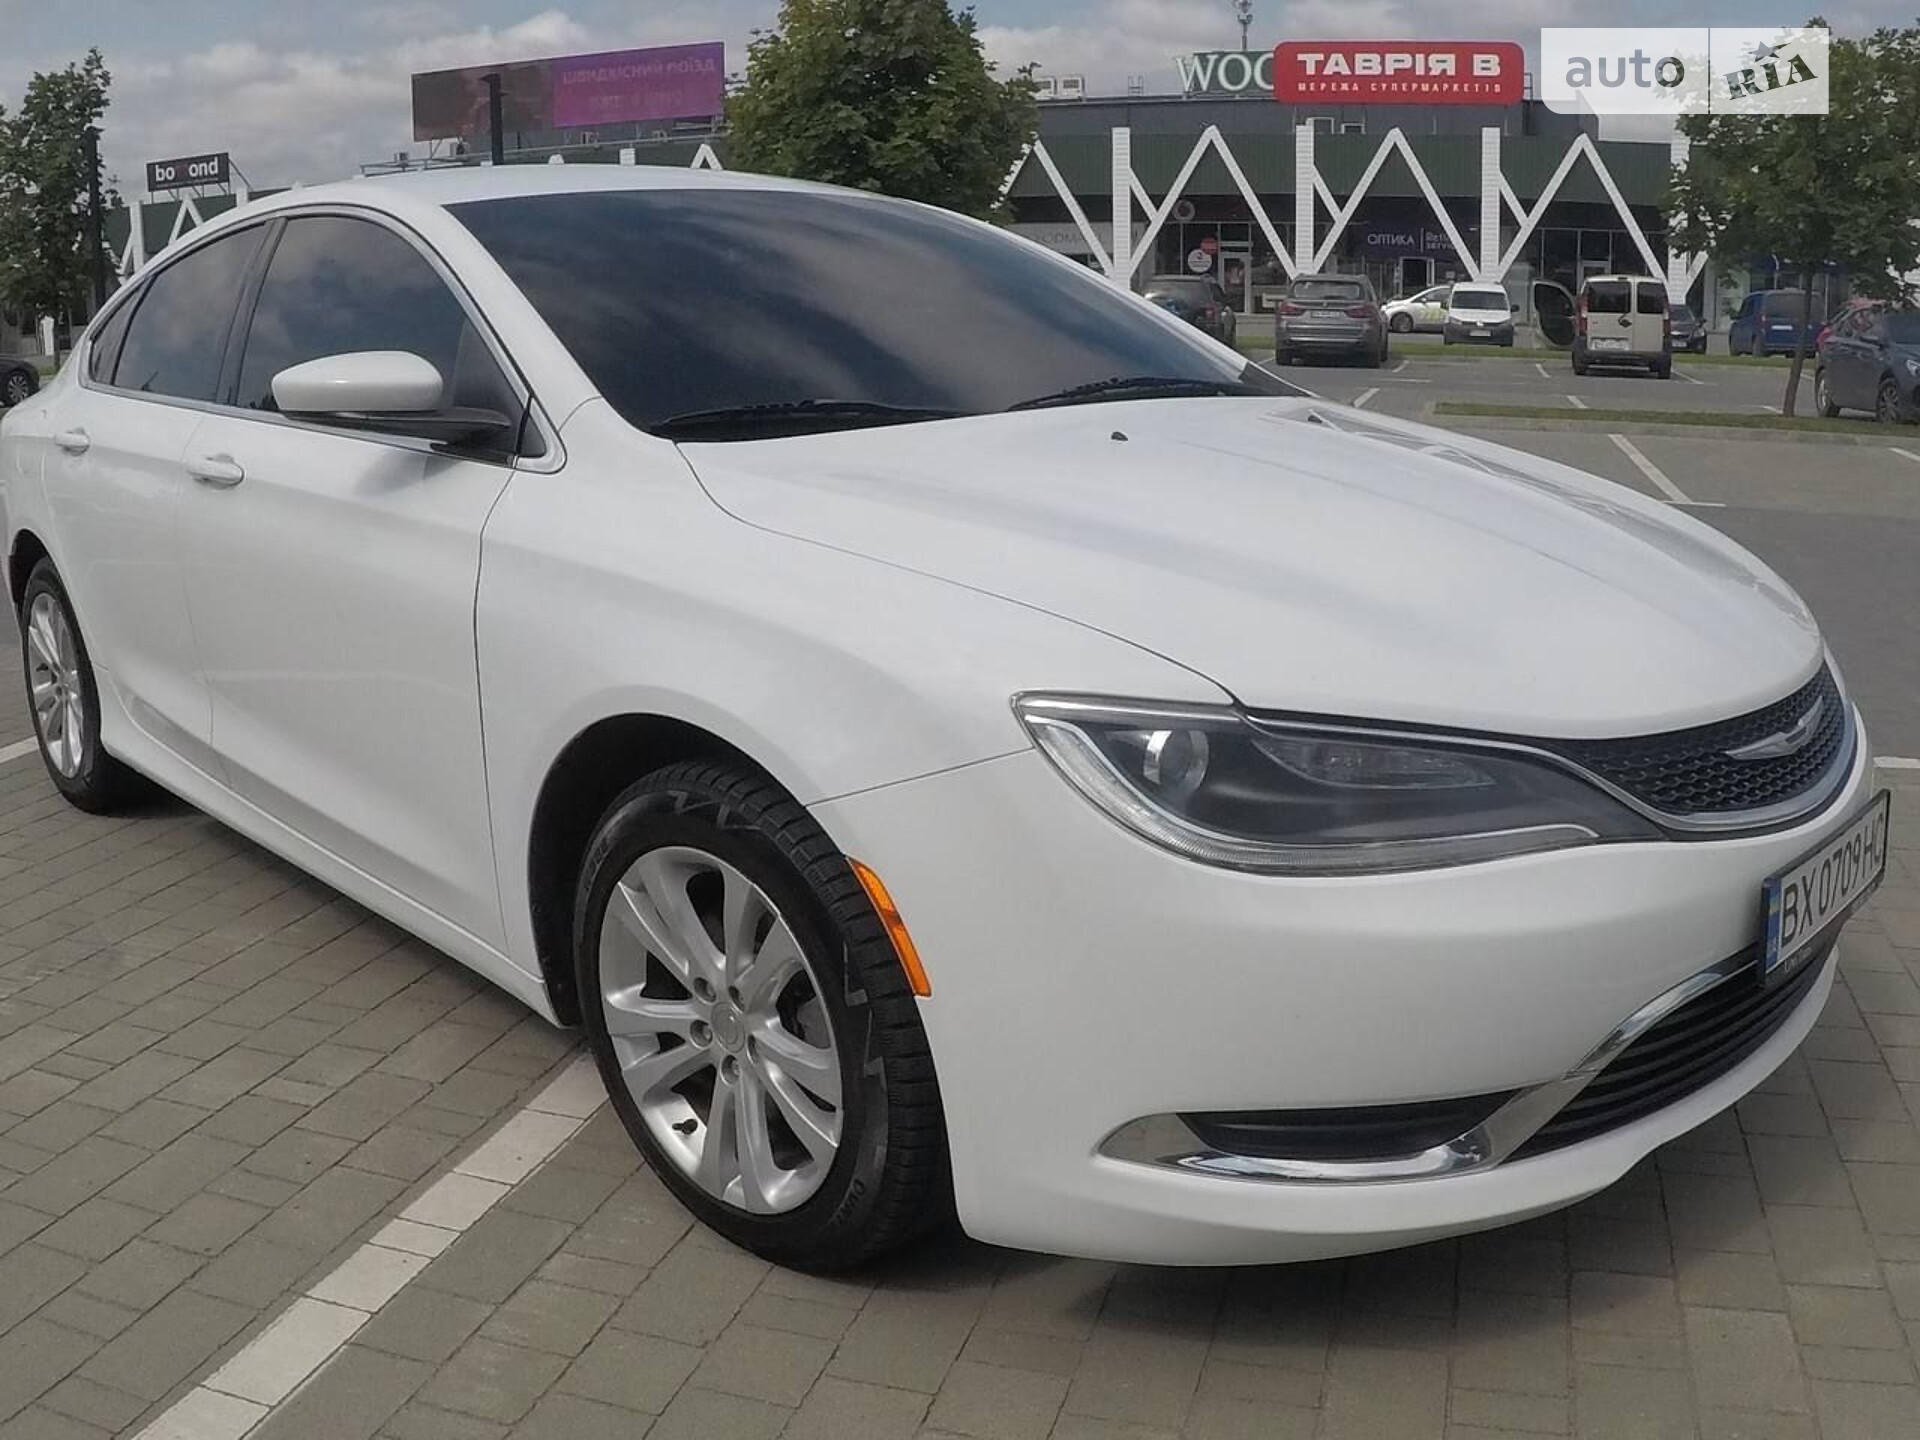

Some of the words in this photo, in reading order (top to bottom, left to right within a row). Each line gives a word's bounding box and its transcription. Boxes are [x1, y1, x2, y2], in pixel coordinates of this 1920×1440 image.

[1297, 53, 1456, 76] ТАВРІЯ
[1473, 54, 1501, 77] В
[1298, 82, 1359, 92] МЕРЕЖА
[1370, 82, 1501, 93] СУПЕРМАРКЕТІВ
[1367, 233, 1415, 246] ОПТИКА
